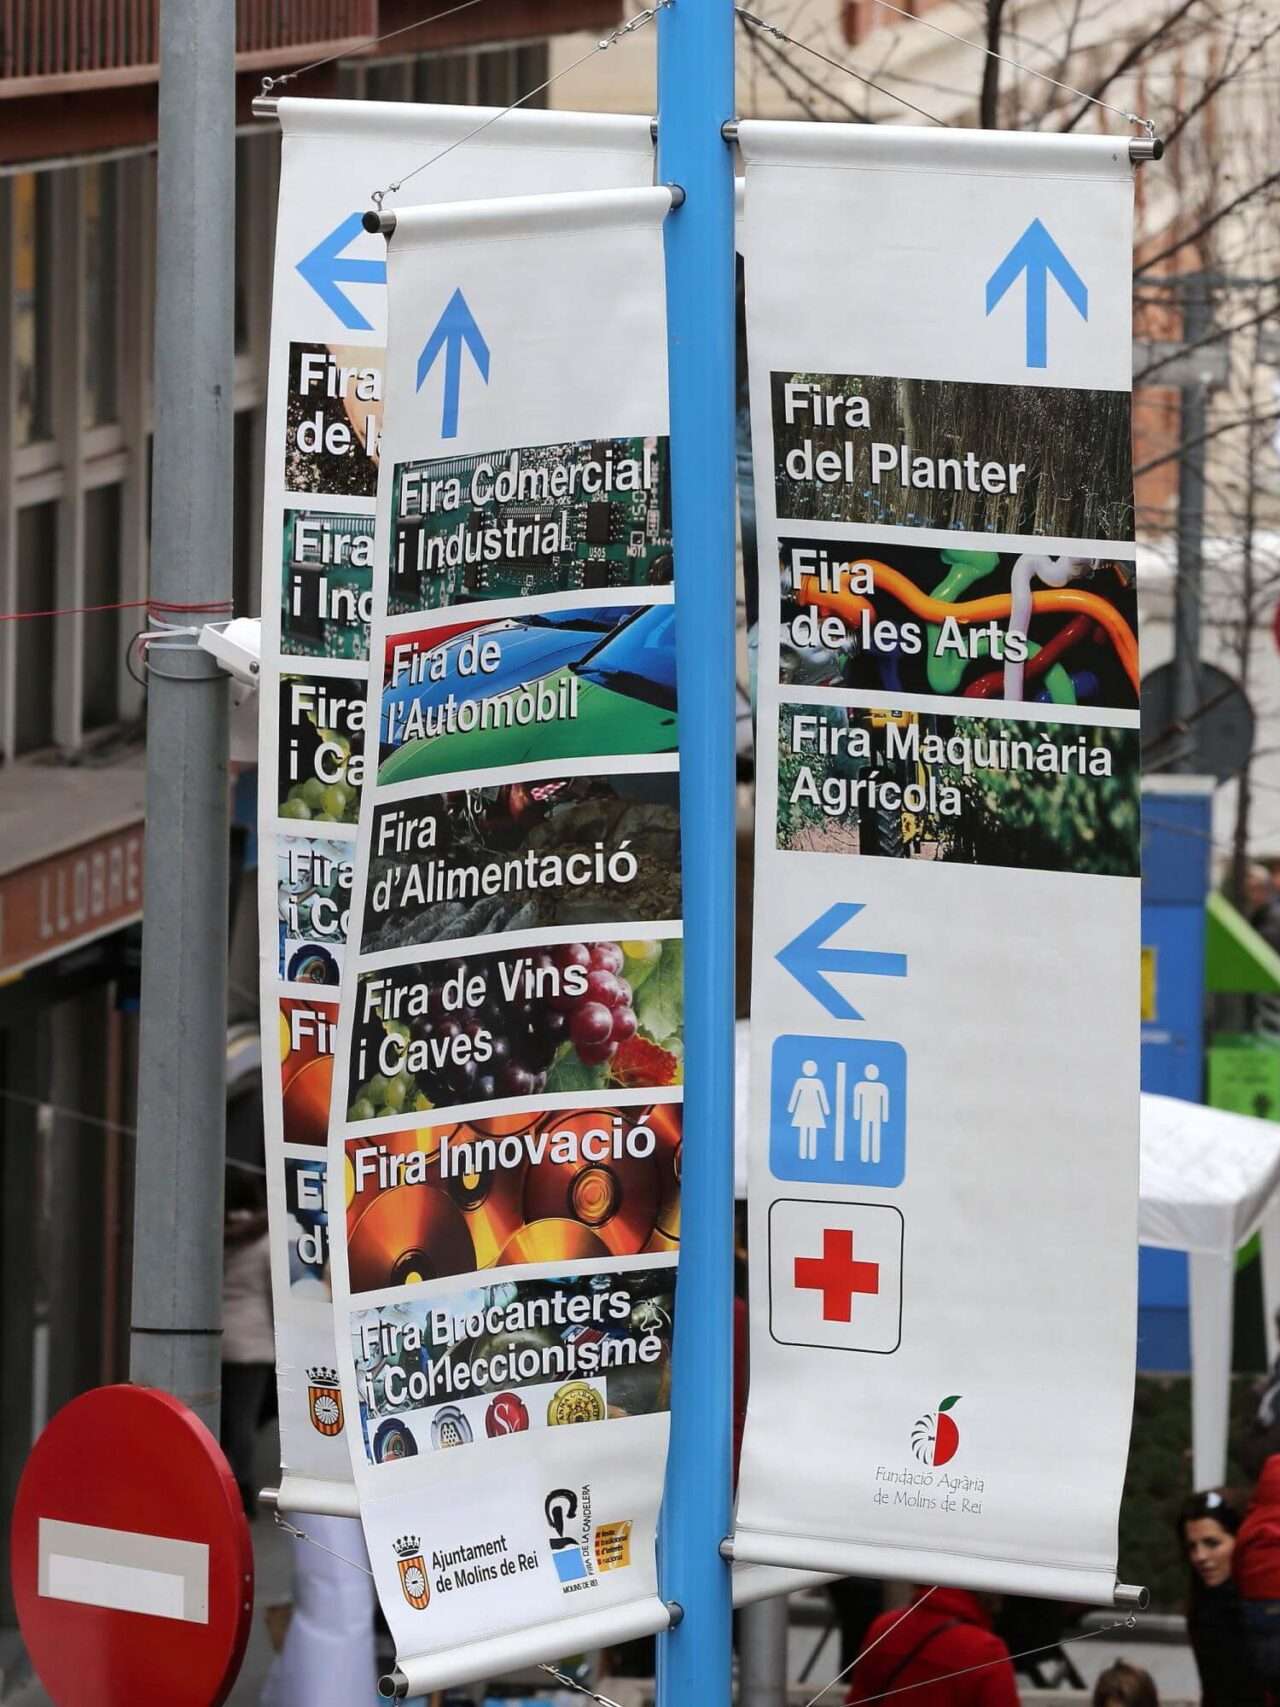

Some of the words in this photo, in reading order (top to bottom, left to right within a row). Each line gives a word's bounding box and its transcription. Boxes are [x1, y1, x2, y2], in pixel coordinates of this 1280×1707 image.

[300, 352, 382, 401] Fira
[783, 382, 871, 429] Fira
[297, 411, 351, 455] de
[366, 414, 381, 456] l
[401, 471, 461, 517] Fira
[470, 446, 652, 507] Comercial
[785, 441, 853, 484] del
[871, 443, 1026, 495] Planter
[295, 520, 374, 567] Fira
[398, 530, 406, 575] i
[417, 511, 568, 572] Industrial
[791, 547, 875, 595] Fira
[293, 575, 301, 617] i
[791, 605, 847, 649] de
[862, 609, 923, 655] les
[936, 615, 1029, 662] Arts
[391, 641, 448, 689] Fira
[458, 633, 502, 676] de
[292, 684, 368, 731] Fira
[388, 676, 579, 745] l'Automòbil
[290, 739, 298, 780] i
[792, 714, 871, 757] Fira
[886, 722, 1113, 778] Maquinària
[790, 767, 962, 818] Agrícola
[377, 811, 437, 857] Fira
[290, 848, 353, 889] Fira
[372, 840, 639, 913] d'Alimentació
[289, 894, 298, 933] i
[363, 978, 429, 1024] Fira
[441, 967, 487, 1012] de
[498, 958, 589, 1002] Vins
[359, 1038, 367, 1081] i
[378, 1028, 493, 1077] Caves
[355, 1145, 427, 1193] Fira
[440, 1115, 657, 1179] Innovació
[361, 1320, 421, 1361] Fira
[431, 1289, 632, 1346] Brocanters
[365, 1375, 375, 1410] i
[873, 1488, 889, 1505] de
[894, 1489, 936, 1510] Molins
[940, 1494, 957, 1513] de
[961, 1498, 982, 1515] Rei
[875, 1465, 934, 1486] Fundació
[937, 1473, 985, 1495] Agrària
[581, 1484, 592, 1533] CANDELERA
[431, 1534, 508, 1572] Ajuntament
[581, 1533, 590, 1544] LA
[581, 1545, 590, 1557] DE
[436, 1575, 453, 1593] de
[454, 1564, 498, 1589] Molins
[499, 1558, 517, 1577] de
[517, 1550, 540, 1572] Rei
